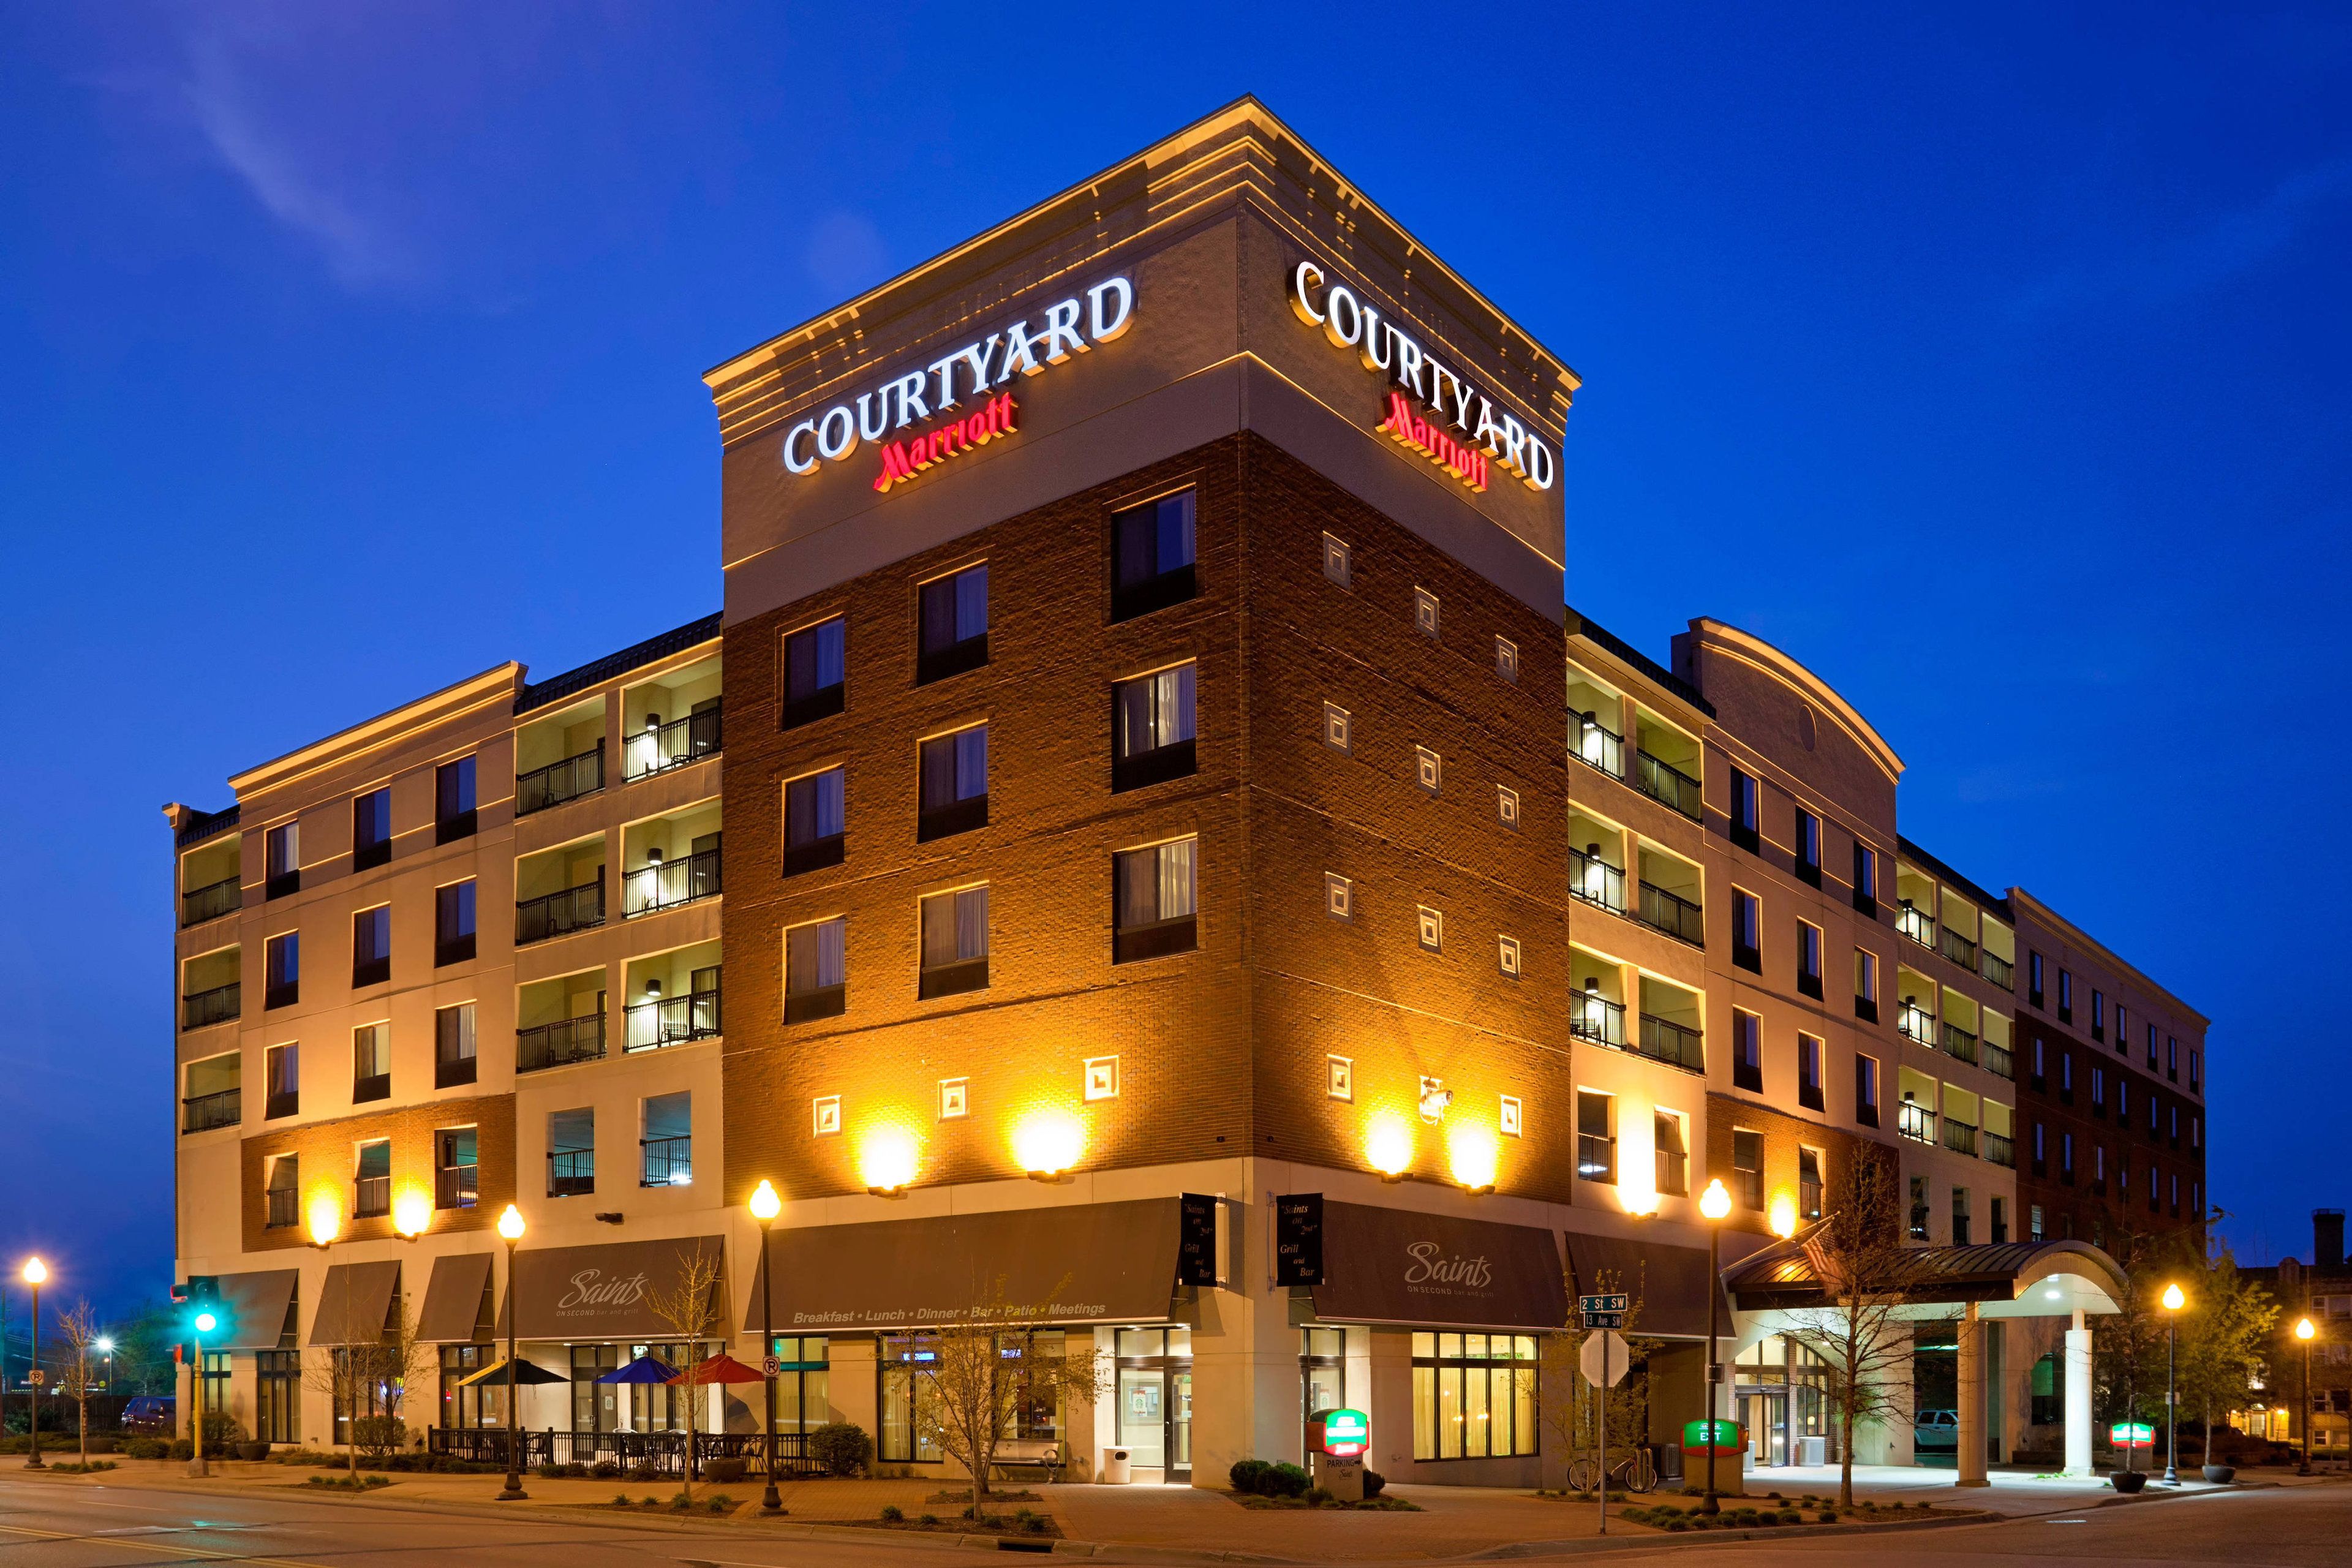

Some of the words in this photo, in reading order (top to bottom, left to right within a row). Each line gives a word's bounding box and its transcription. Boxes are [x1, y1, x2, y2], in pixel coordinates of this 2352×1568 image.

[783, 277, 1134, 475] COURTYARD
[1296, 261, 1554, 489] COURTYARD
[873, 392, 1014, 491] Marriott
[1384, 392, 1488, 489] Marriott
[1185, 1243, 1200, 1254] Grill
[1280, 1244, 1298, 1254] Grill
[1404, 1241, 1493, 1288] Saints
[1199, 1268, 1211, 1278] Bar
[1300, 1267, 1315, 1277] Bar
[557, 1268, 650, 1308] Saints
[1420, 1286, 1452, 1295] SECOND
[1582, 1299, 1588, 1310] 2
[1594, 1298, 1604, 1310] St
[1611, 1297, 1624, 1308] SW
[793, 1311, 855, 1324] Breakfast
[865, 1309, 906, 1321] Lunch
[917, 1308, 960, 1319] Dinner
[971, 1306, 993, 1317] Bar
[1004, 1305, 1037, 1316] Patio
[1048, 1303, 1106, 1316] Meetings
[1586, 1314, 1593, 1325] 13
[1597, 1316, 1608, 1326] Ave
[1612, 1316, 1621, 1327] SW
[1327, 1459, 1354, 1468] PARKING
